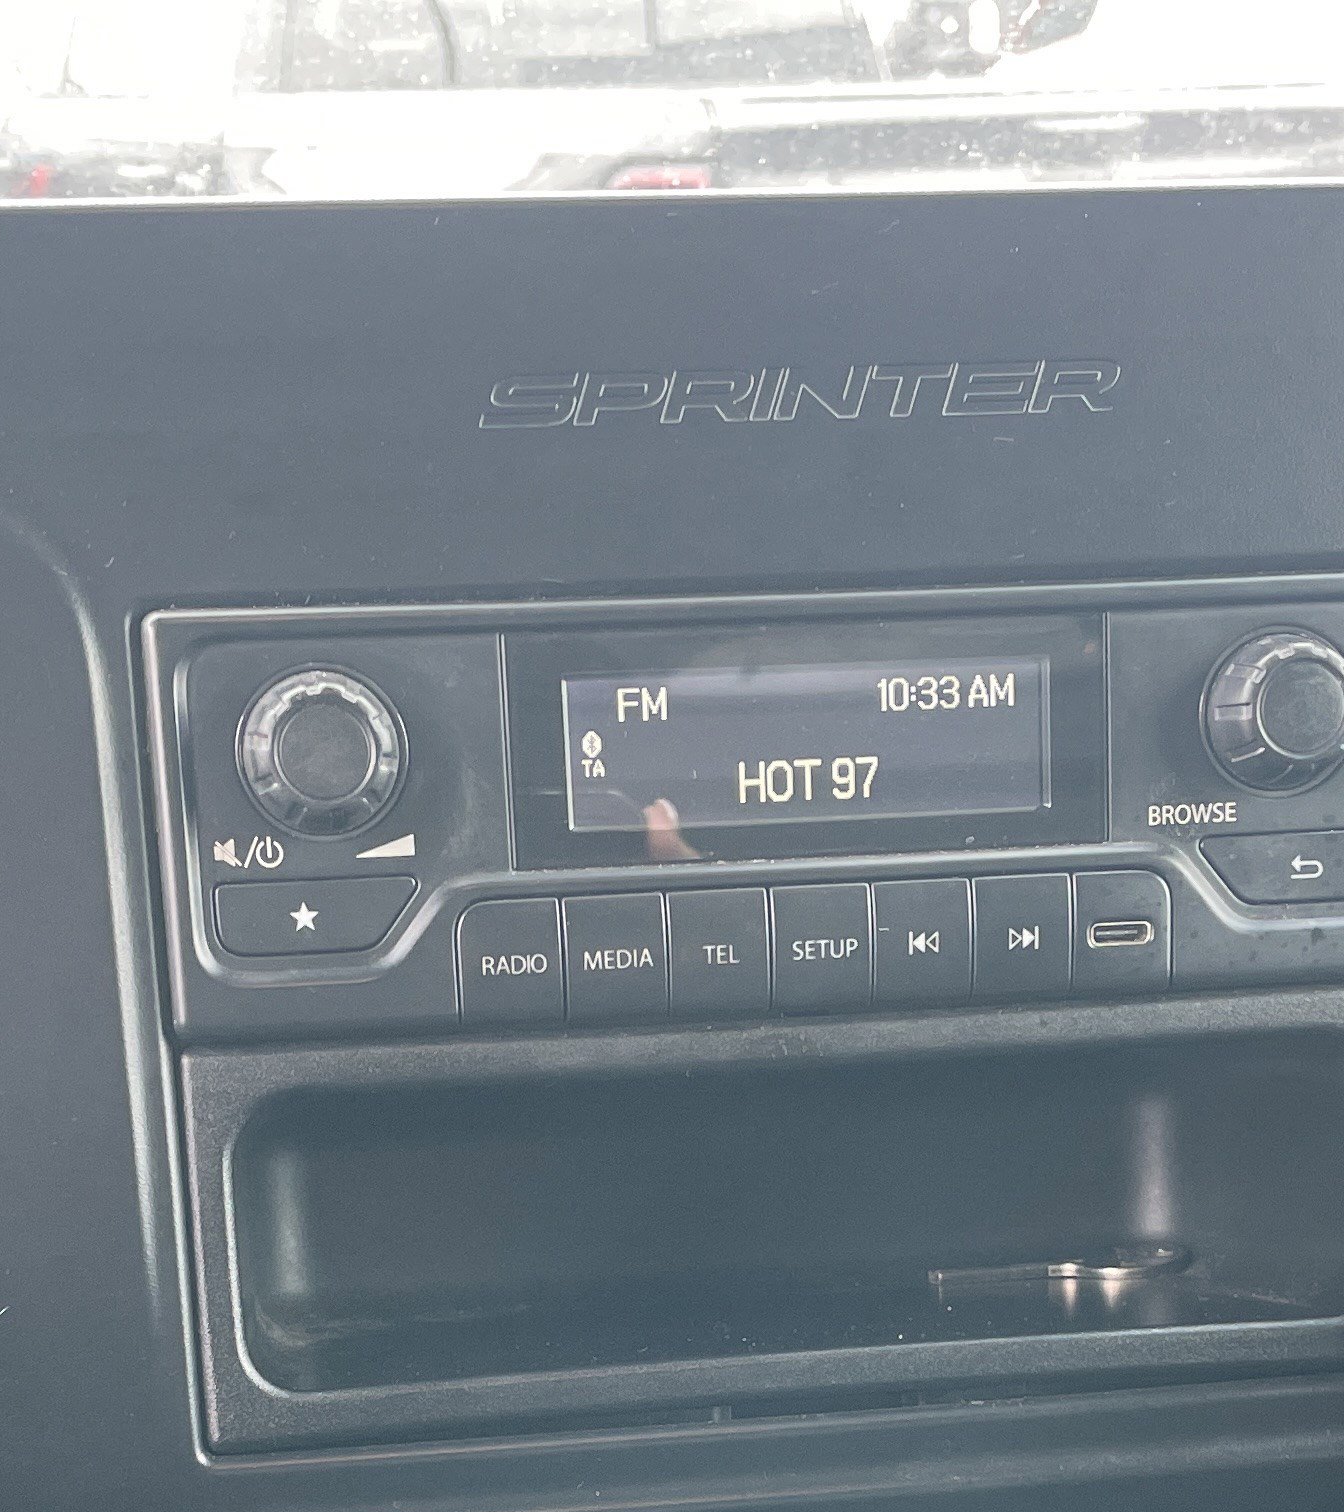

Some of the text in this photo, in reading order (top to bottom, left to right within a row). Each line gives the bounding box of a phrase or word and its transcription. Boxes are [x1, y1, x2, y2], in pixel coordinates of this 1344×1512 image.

[479, 360, 1120, 429] SPRINTER
[877, 673, 1016, 712] 10:33 AM
[616, 687, 669, 723] FM
[581, 758, 605, 778] TA
[738, 756, 879, 803] HOT 97
[1148, 802, 1237, 826] BROWSE
[583, 948, 654, 971] MEDIA
[702, 944, 741, 965] TEL
[792, 938, 859, 961] SETUP
[481, 953, 548, 976] RADIO
